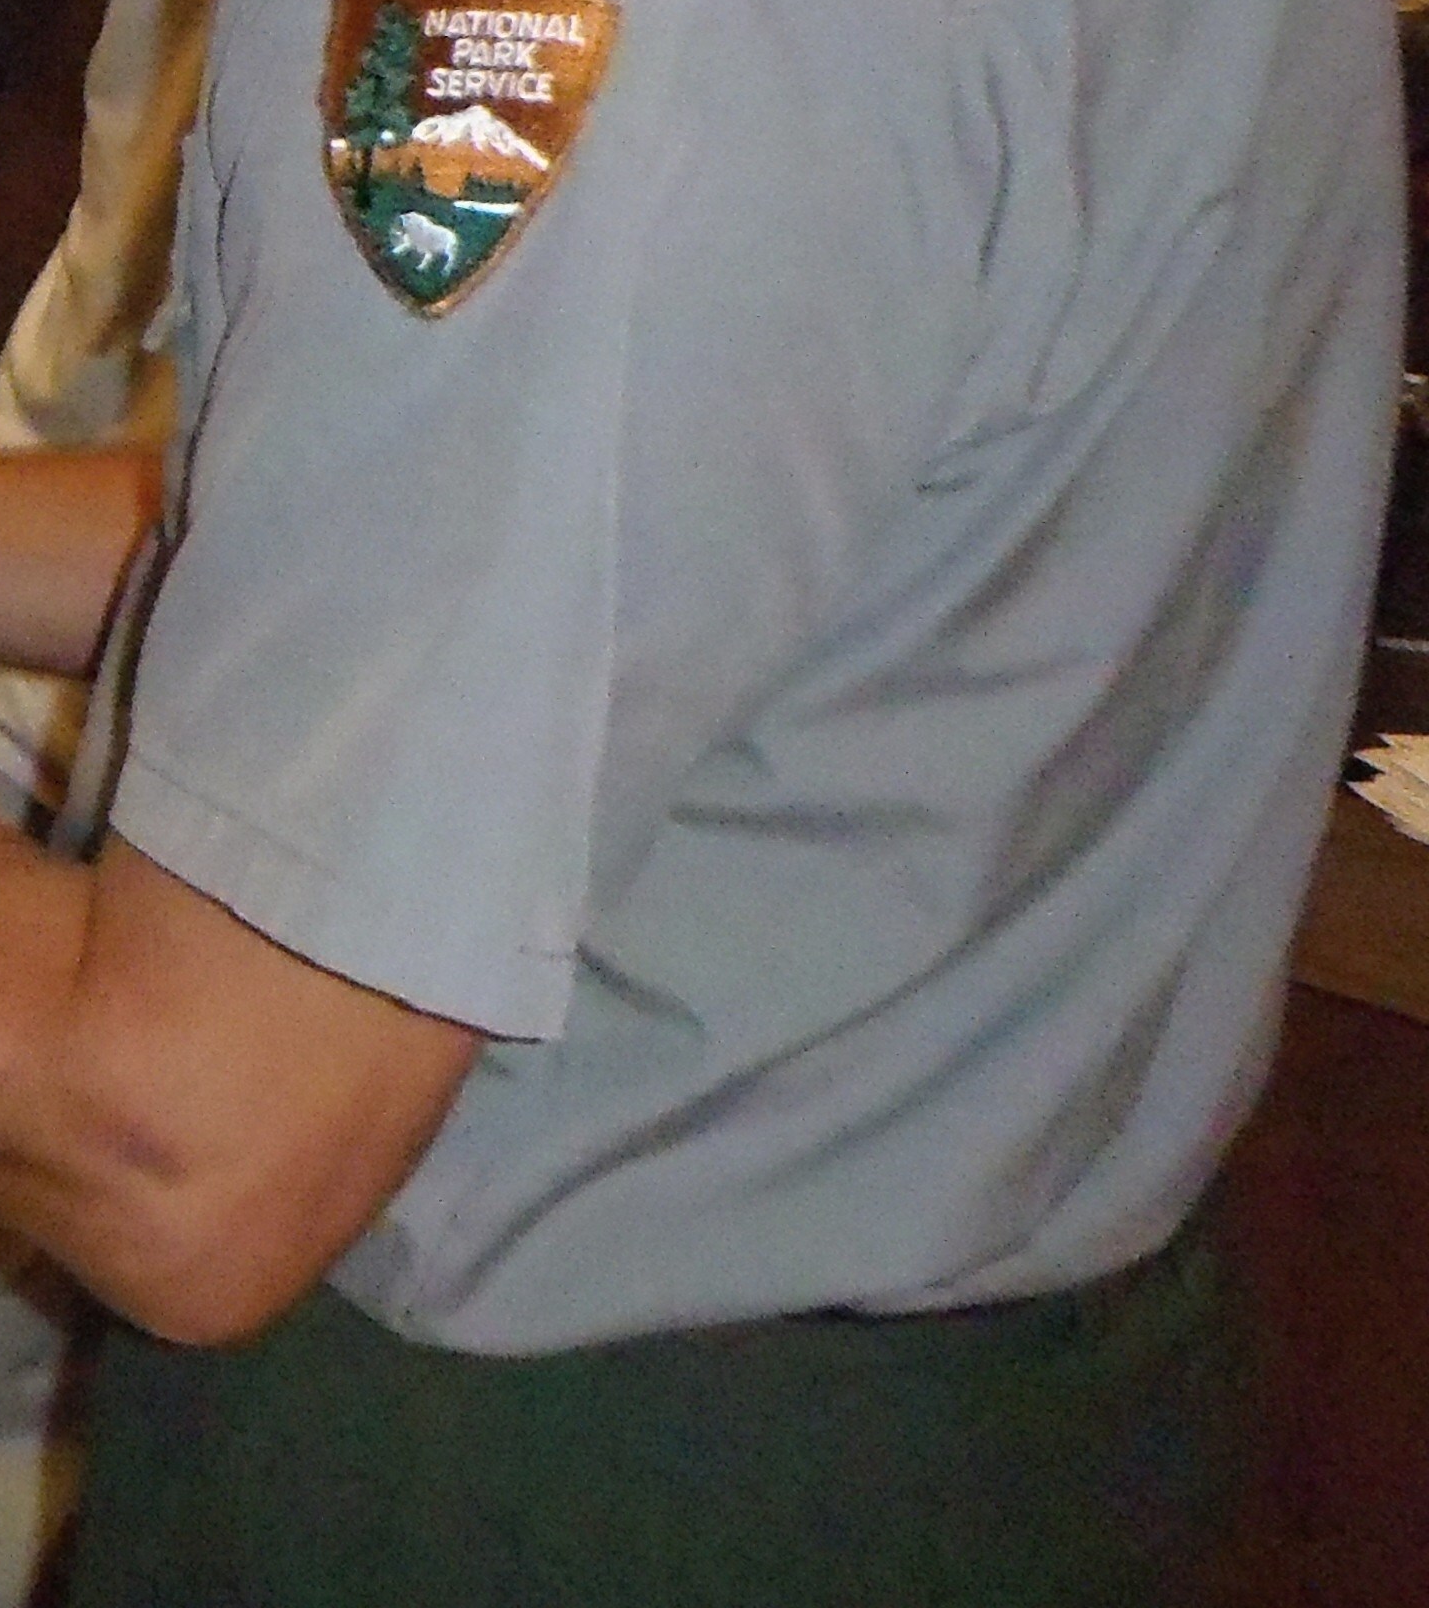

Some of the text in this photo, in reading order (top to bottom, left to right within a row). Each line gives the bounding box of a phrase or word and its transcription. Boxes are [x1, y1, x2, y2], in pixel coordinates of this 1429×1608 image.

[424, 9, 586, 45] NATIONAL
[450, 38, 537, 69] PARK
[425, 68, 555, 102] SERVICE
